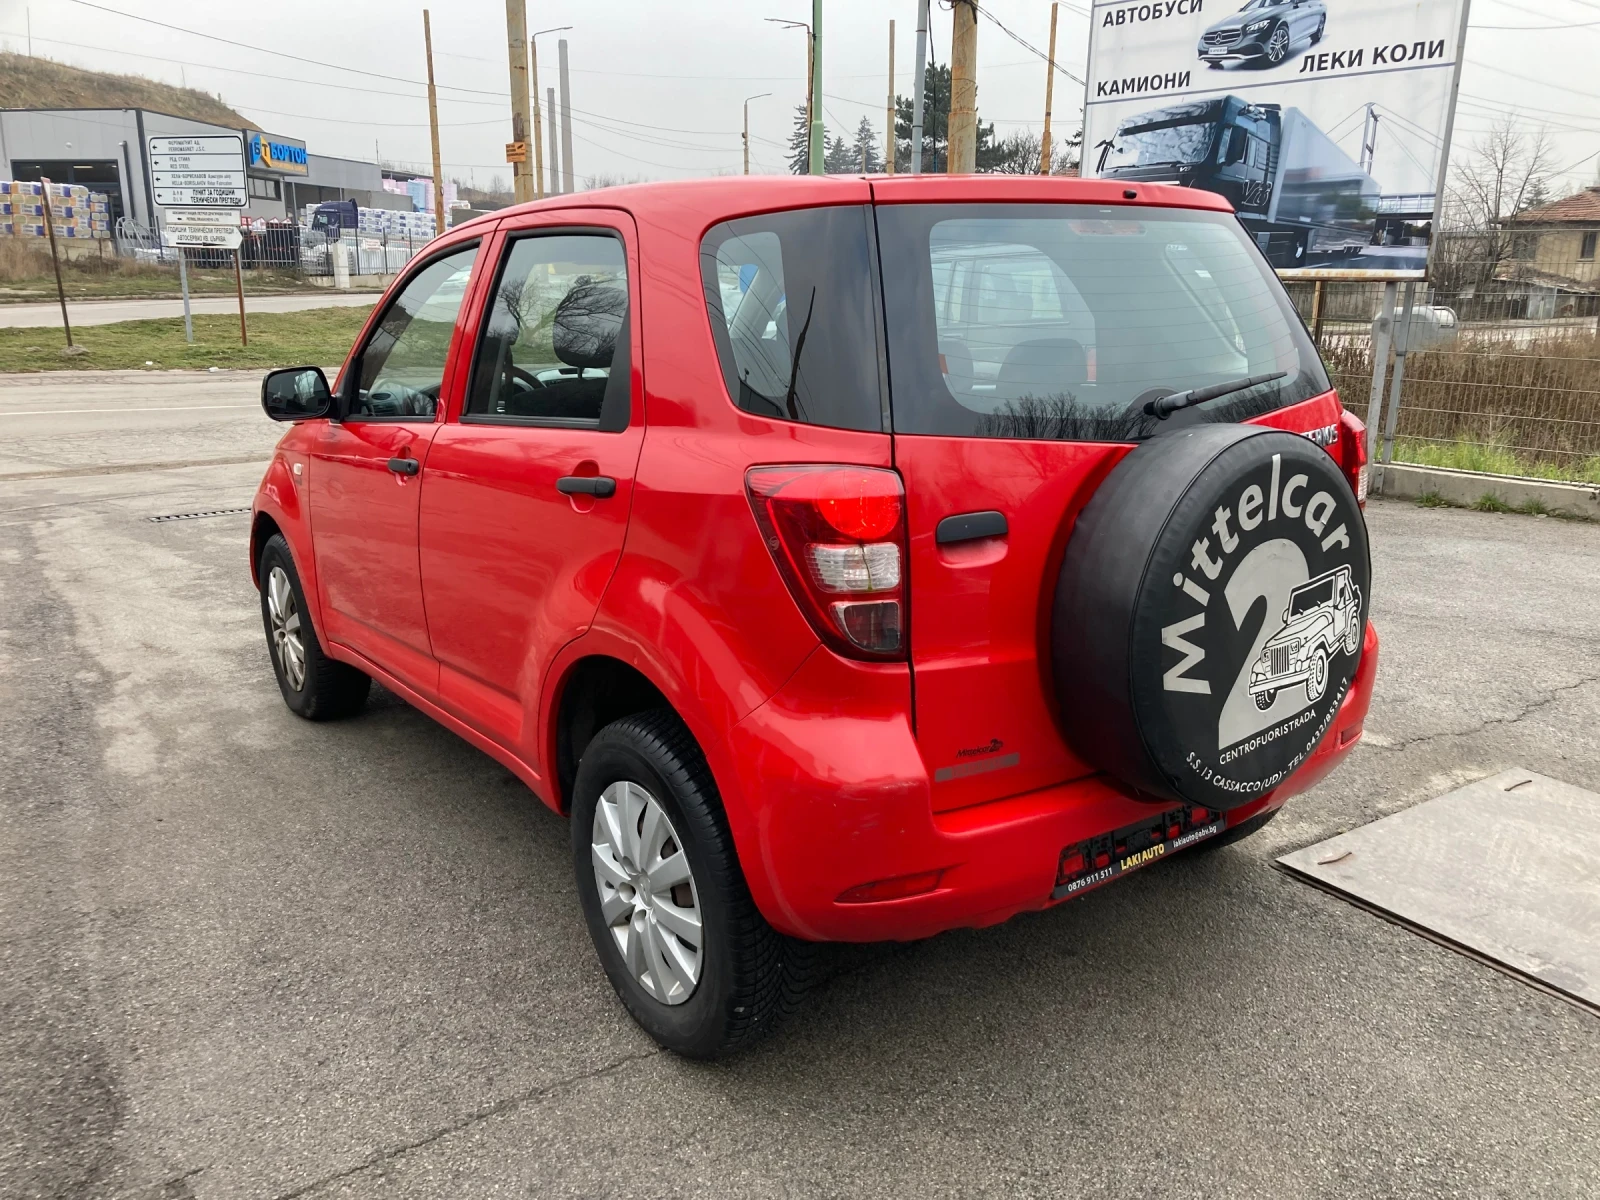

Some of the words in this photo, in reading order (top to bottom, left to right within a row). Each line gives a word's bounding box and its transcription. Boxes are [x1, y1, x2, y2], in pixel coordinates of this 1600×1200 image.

[1103, 0, 1203, 28] АВТОБУСИ
[1299, 49, 1364, 74] ЛЕКИ
[1372, 39, 1445, 65] КОЛИ
[1097, 70, 1191, 97] КАМИОНИ
[269, 142, 307, 165] БОРТОН
[190, 196, 218, 204] ТЕХНИЧЕСКИ
[1161, 453, 1350, 695] Mittelcar
[1219, 708, 1316, 765] CENTROFUORISTRADA
[1067, 878, 1086, 892] 0876
[1086, 872, 1099, 885] 911
[1100, 866, 1113, 879] 511
[1121, 852, 1142, 870] LAKI
[1141, 843, 1165, 862] AUTO
[1172, 825, 1217, 849] lakiauto@abv.bg
